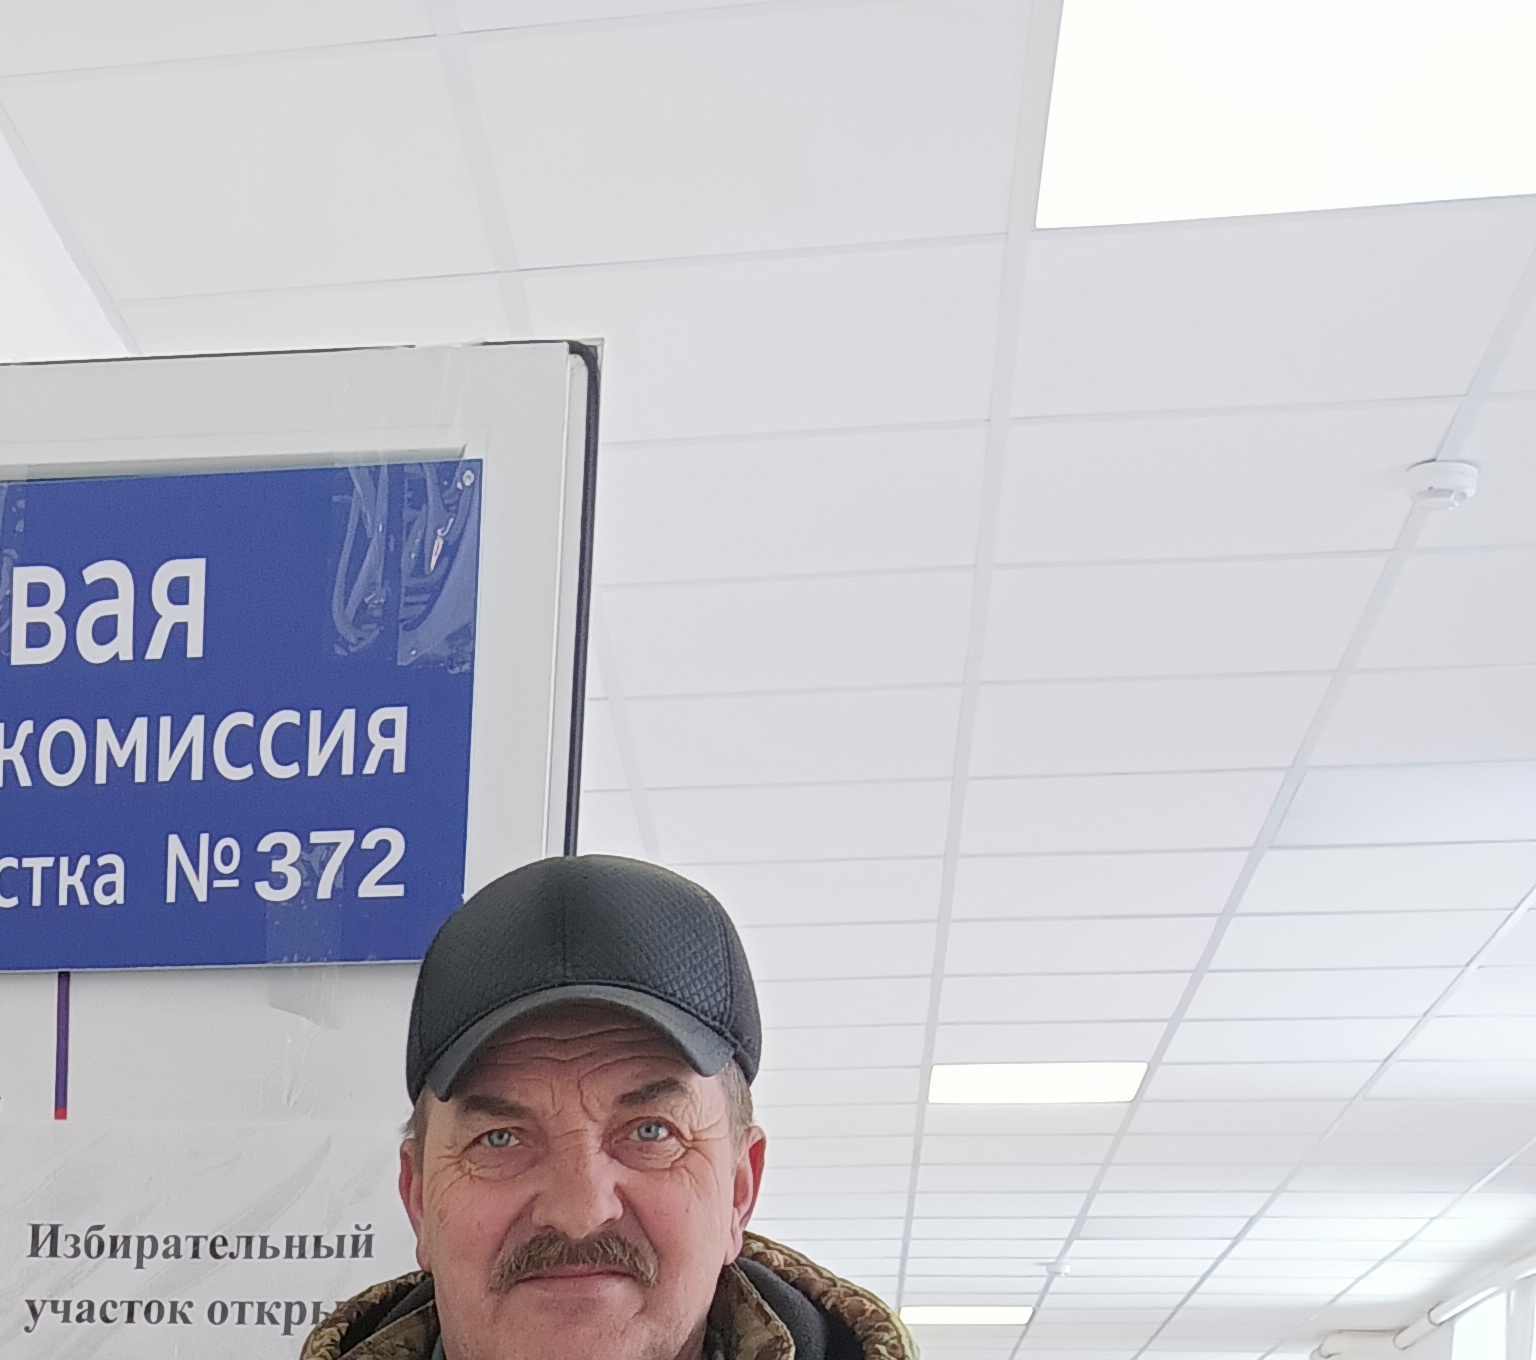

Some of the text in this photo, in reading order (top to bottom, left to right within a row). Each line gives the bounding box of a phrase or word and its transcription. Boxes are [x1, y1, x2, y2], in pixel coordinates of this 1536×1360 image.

[26, 1222, 375, 1270] Избирательный
[23, 1298, 348, 1336] участок откры
